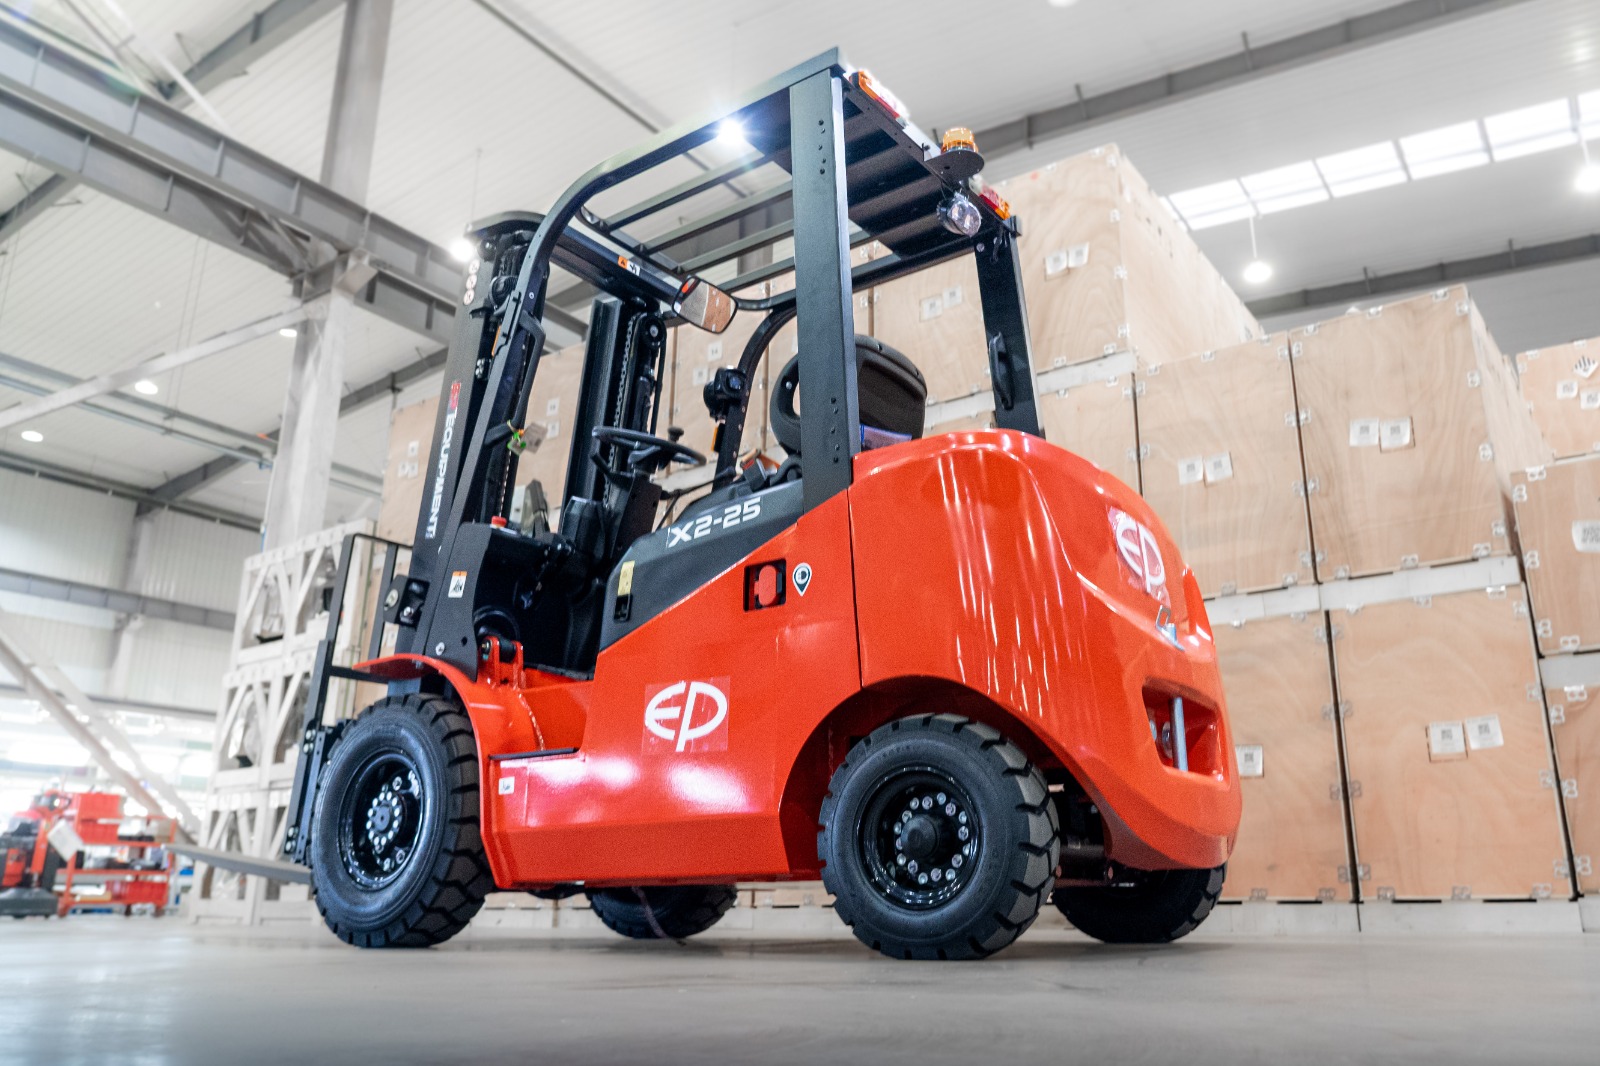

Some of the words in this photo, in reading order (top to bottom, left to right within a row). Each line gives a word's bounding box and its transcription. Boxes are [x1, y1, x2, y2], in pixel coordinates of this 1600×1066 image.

[427, 412, 456, 538] EQUIPMENT
[668, 497, 761, 548] X2-25
[1115, 514, 1166, 593] EP
[644, 681, 728, 752] EP
